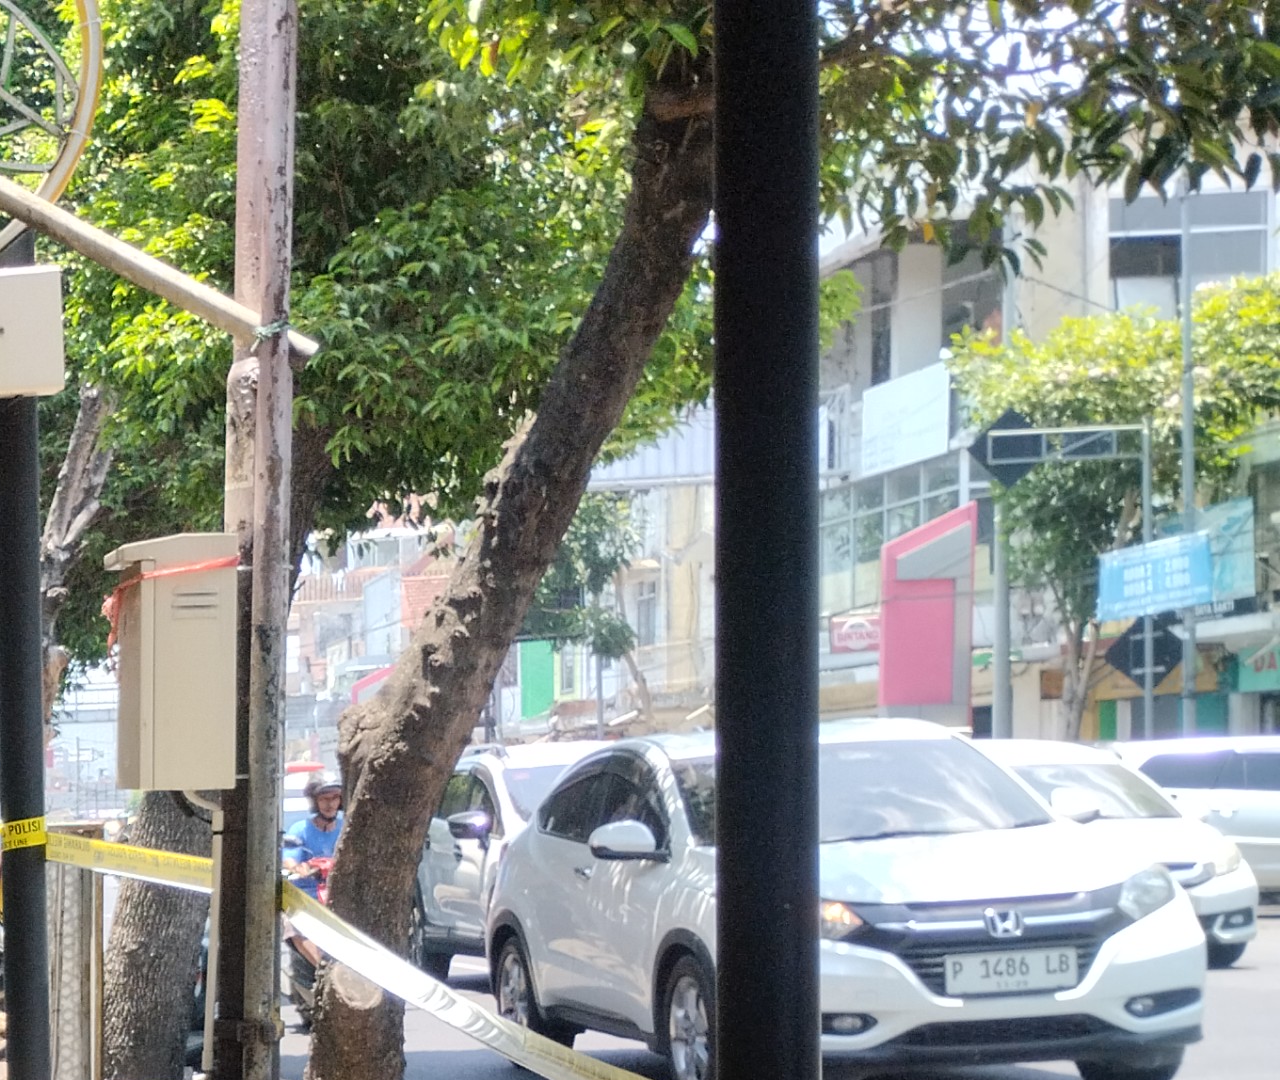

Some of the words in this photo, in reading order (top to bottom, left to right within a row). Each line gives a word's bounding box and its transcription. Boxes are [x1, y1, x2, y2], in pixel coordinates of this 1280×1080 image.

[8, 816, 41, 835] POLISI
[952, 961, 963, 980] P
[980, 956, 1030, 979] 1486
[1045, 954, 1070, 974] LB
